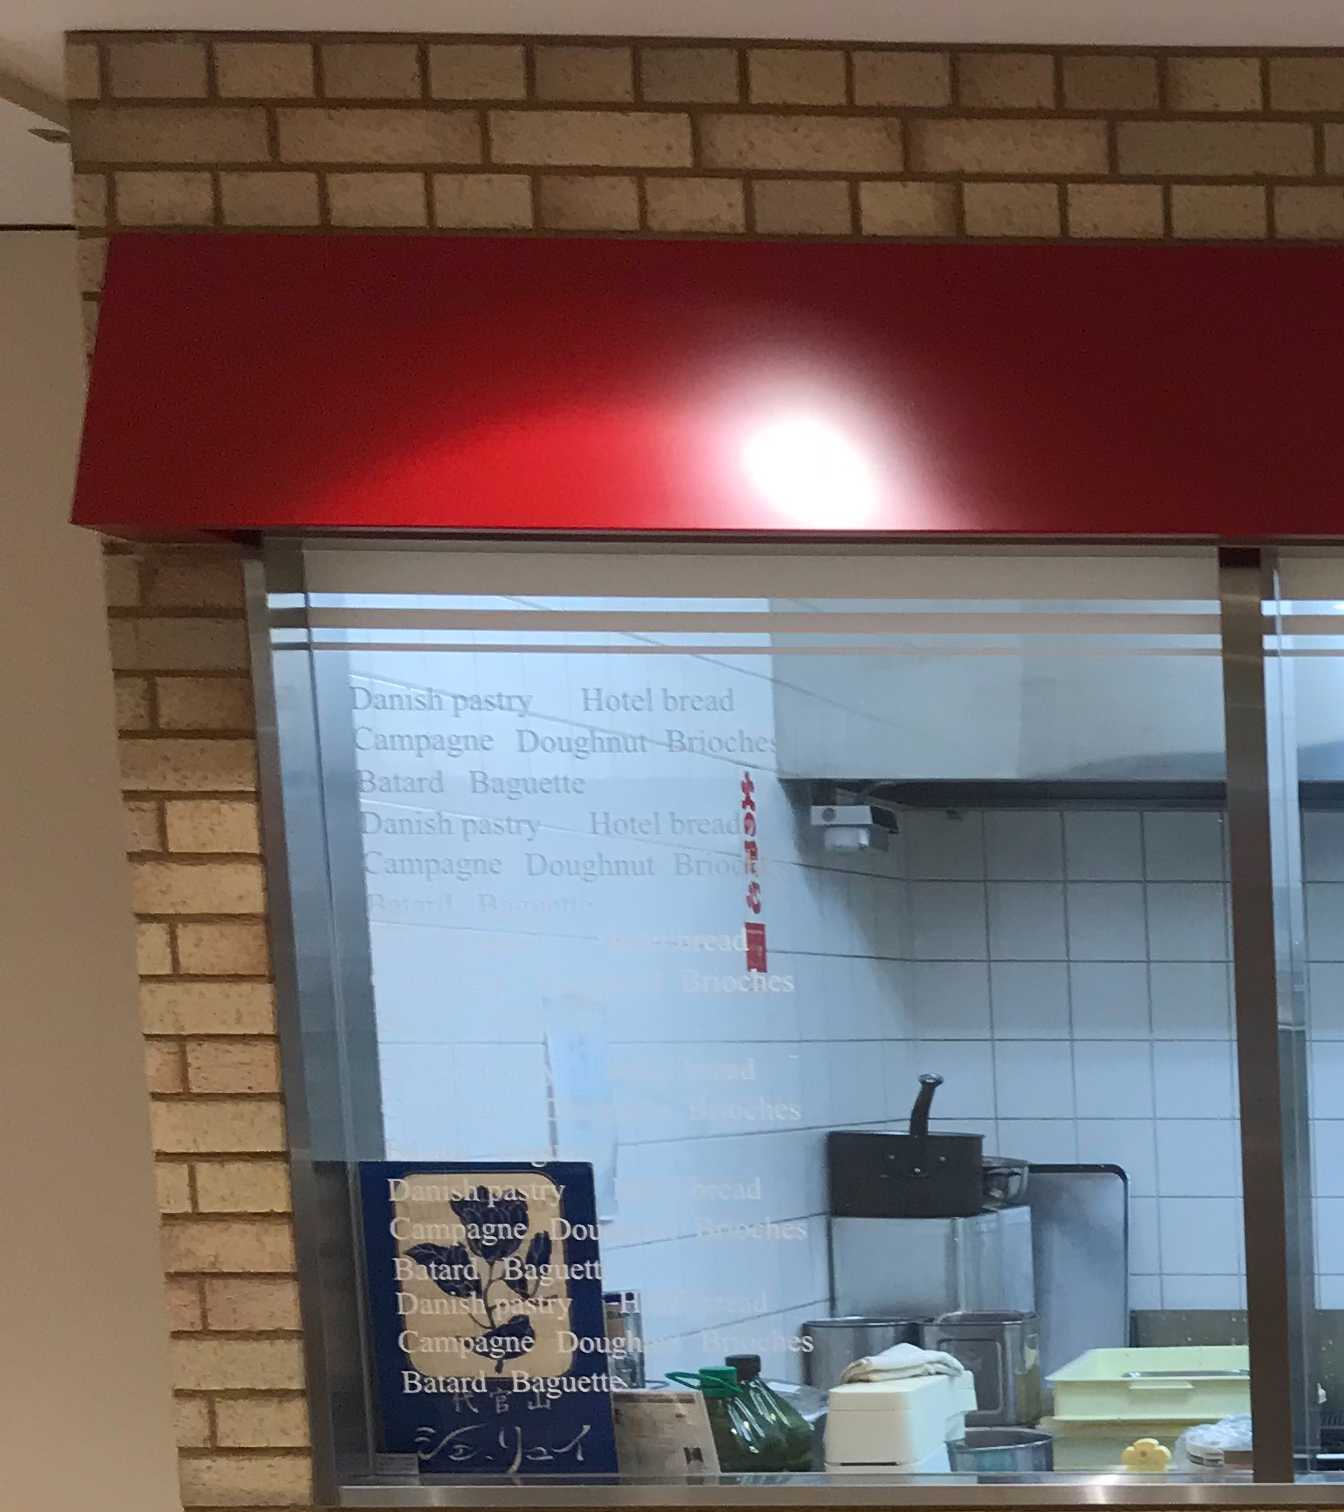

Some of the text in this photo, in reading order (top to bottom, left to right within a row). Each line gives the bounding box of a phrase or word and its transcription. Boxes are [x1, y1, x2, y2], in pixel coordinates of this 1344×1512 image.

[351, 685, 735, 717] Danish pastry Hotel bread
[353, 726, 776, 759] Campagne Doughnut Brioches
[358, 770, 586, 800] Batard Baguette
[361, 812, 740, 841] Danish pastry Hotel bread
[364, 851, 502, 881] Campagne
[526, 852, 654, 882] Doughnut
[388, 1178, 479, 1202] Danish
[488, 1182, 565, 1208] pastry
[390, 1217, 527, 1246] Campagne
[393, 1257, 480, 1282] Batard
[396, 1291, 573, 1321] Danish pastry
[399, 1331, 535, 1360] Campagne
[402, 1370, 623, 1398] Batard Baguette
